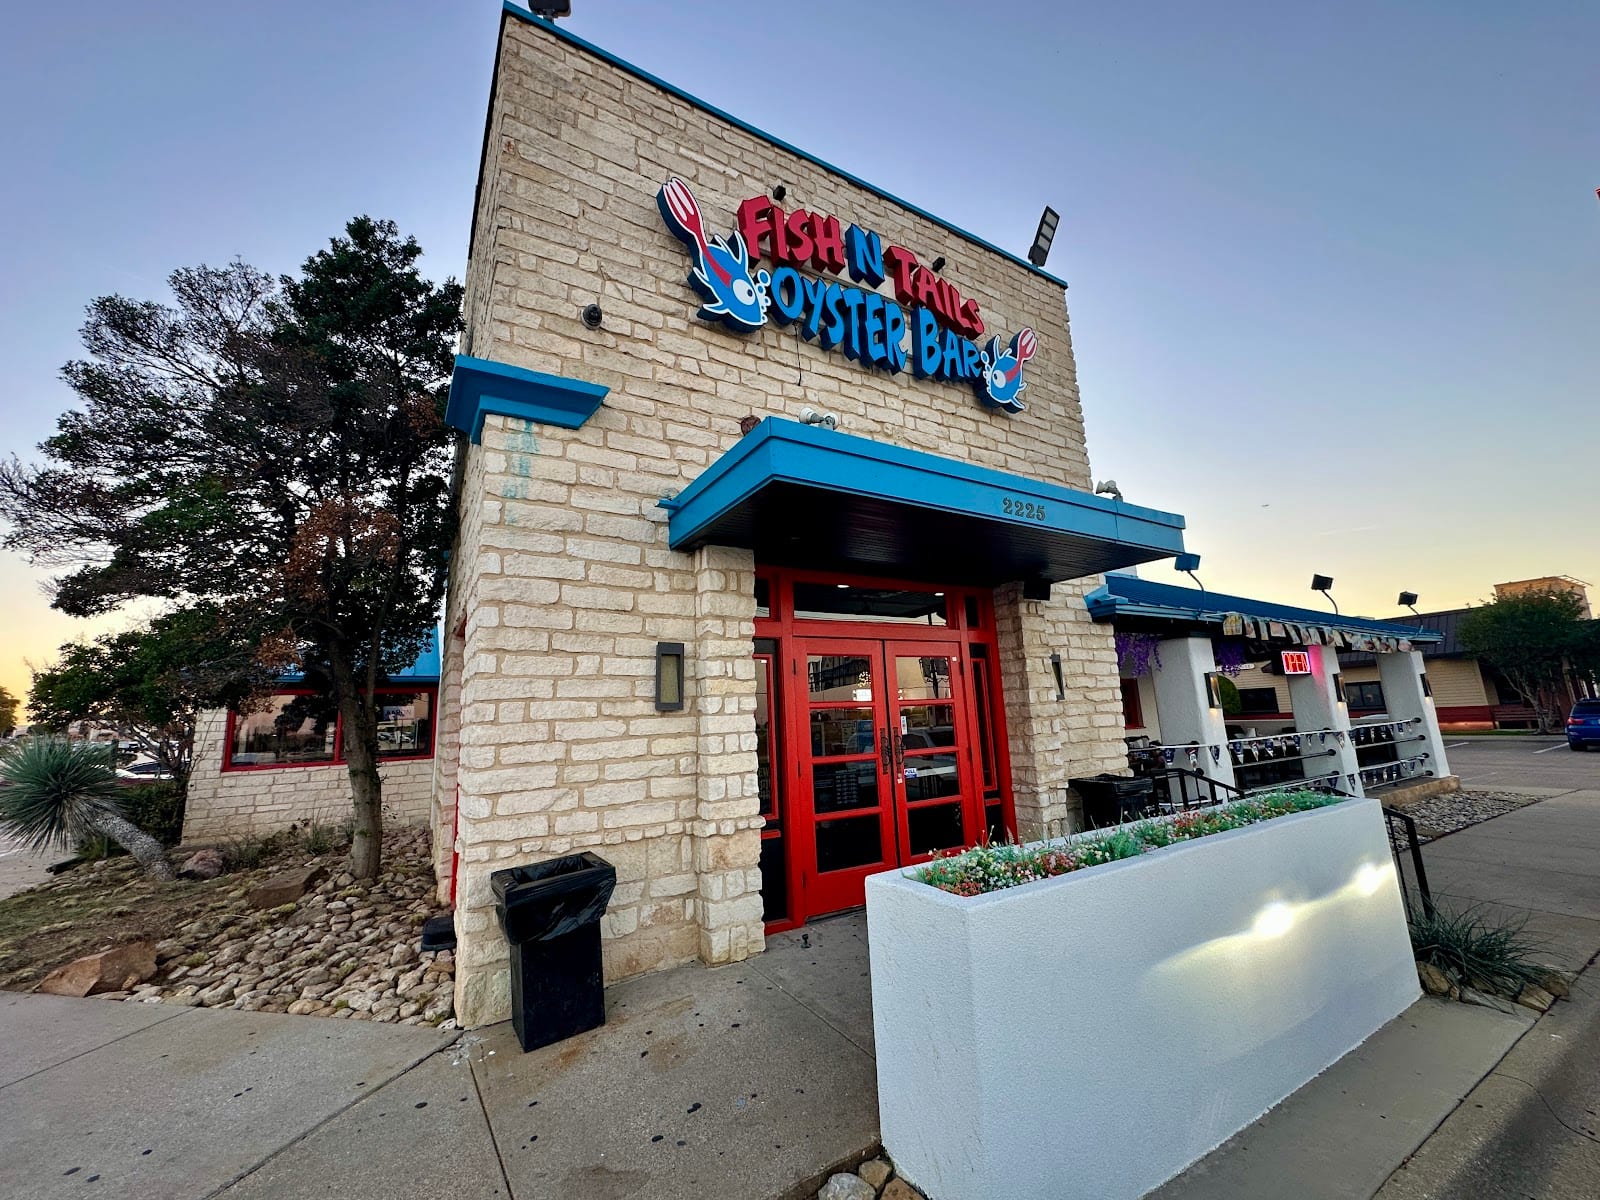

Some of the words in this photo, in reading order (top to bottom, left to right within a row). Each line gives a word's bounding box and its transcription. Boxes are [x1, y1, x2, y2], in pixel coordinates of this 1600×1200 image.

[739, 195, 845, 271] FISH
[847, 223, 885, 286] N
[885, 246, 985, 338] TAILS
[770, 266, 909, 372] OYSTER
[914, 303, 983, 378] BAR
[1002, 497, 1046, 521] 2225
[1283, 653, 1308, 672] OPEN
